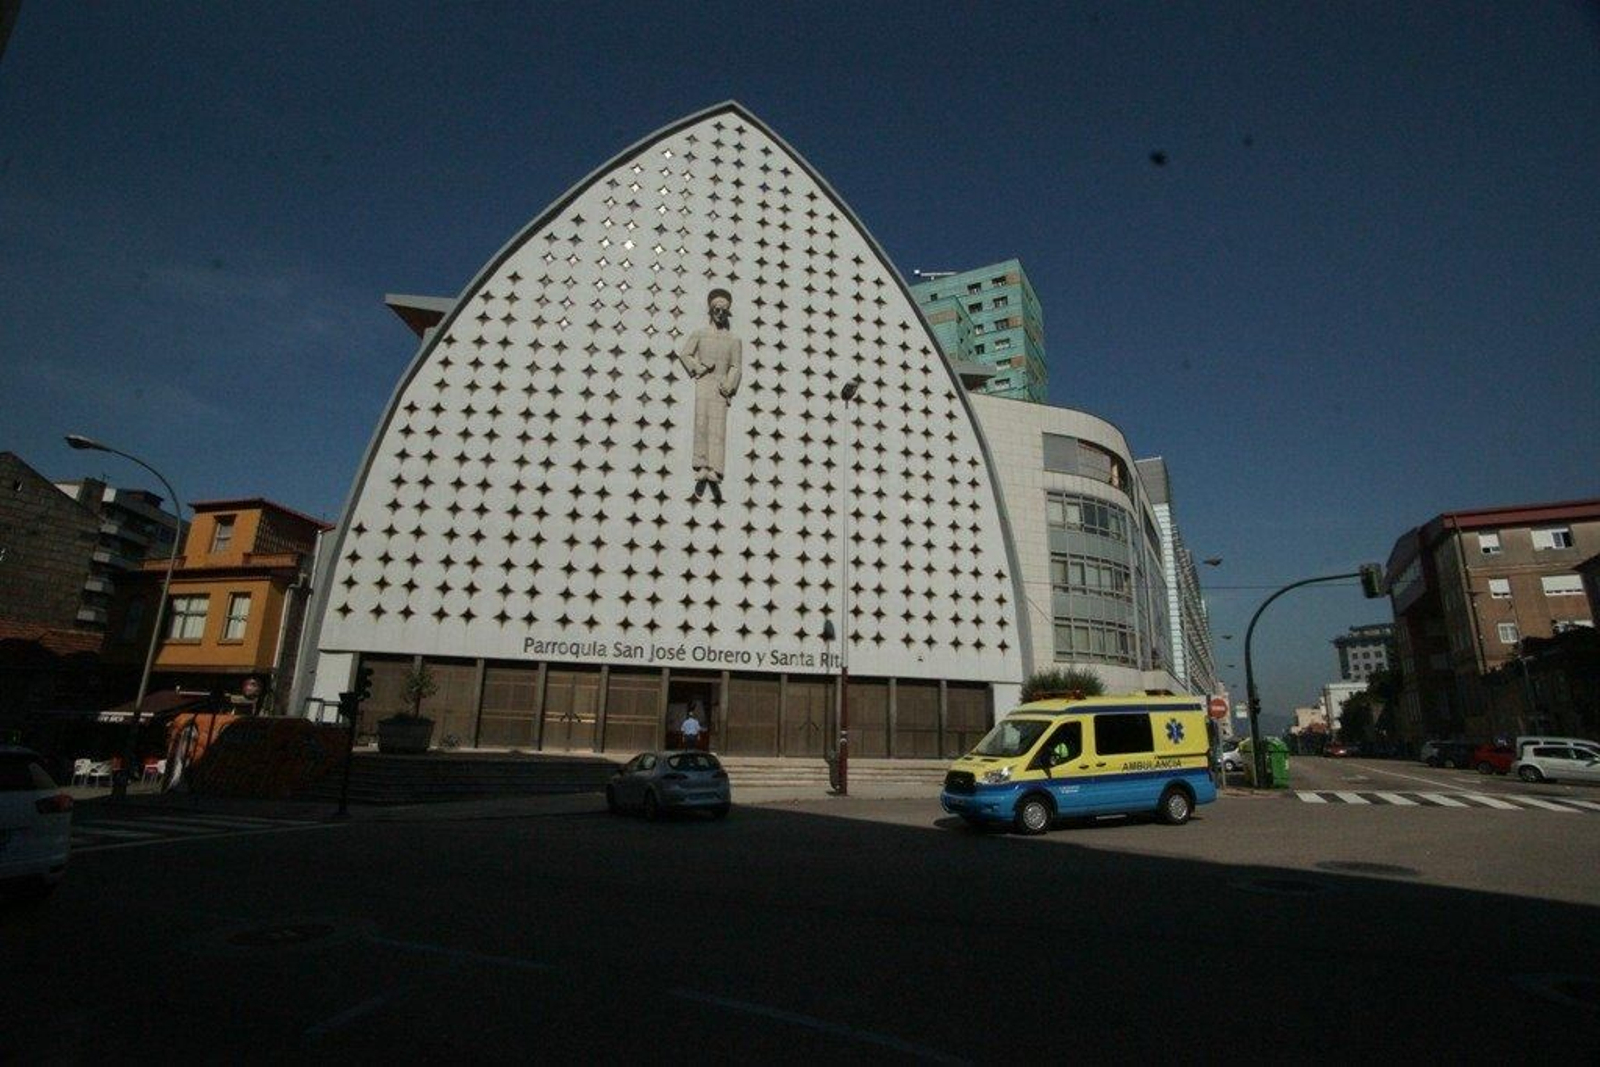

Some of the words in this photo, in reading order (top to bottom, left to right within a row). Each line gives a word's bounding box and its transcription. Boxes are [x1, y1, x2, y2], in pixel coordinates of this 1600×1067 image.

[523, 637, 608, 659] Parroquia
[613, 641, 644, 659] San
[647, 644, 687, 663] José
[692, 646, 751, 663] Obrero
[755, 651, 767, 667] y
[770, 649, 815, 667] Santa
[820, 652, 846, 669] Rit
[1121, 759, 1182, 772] AMBULANCIA
